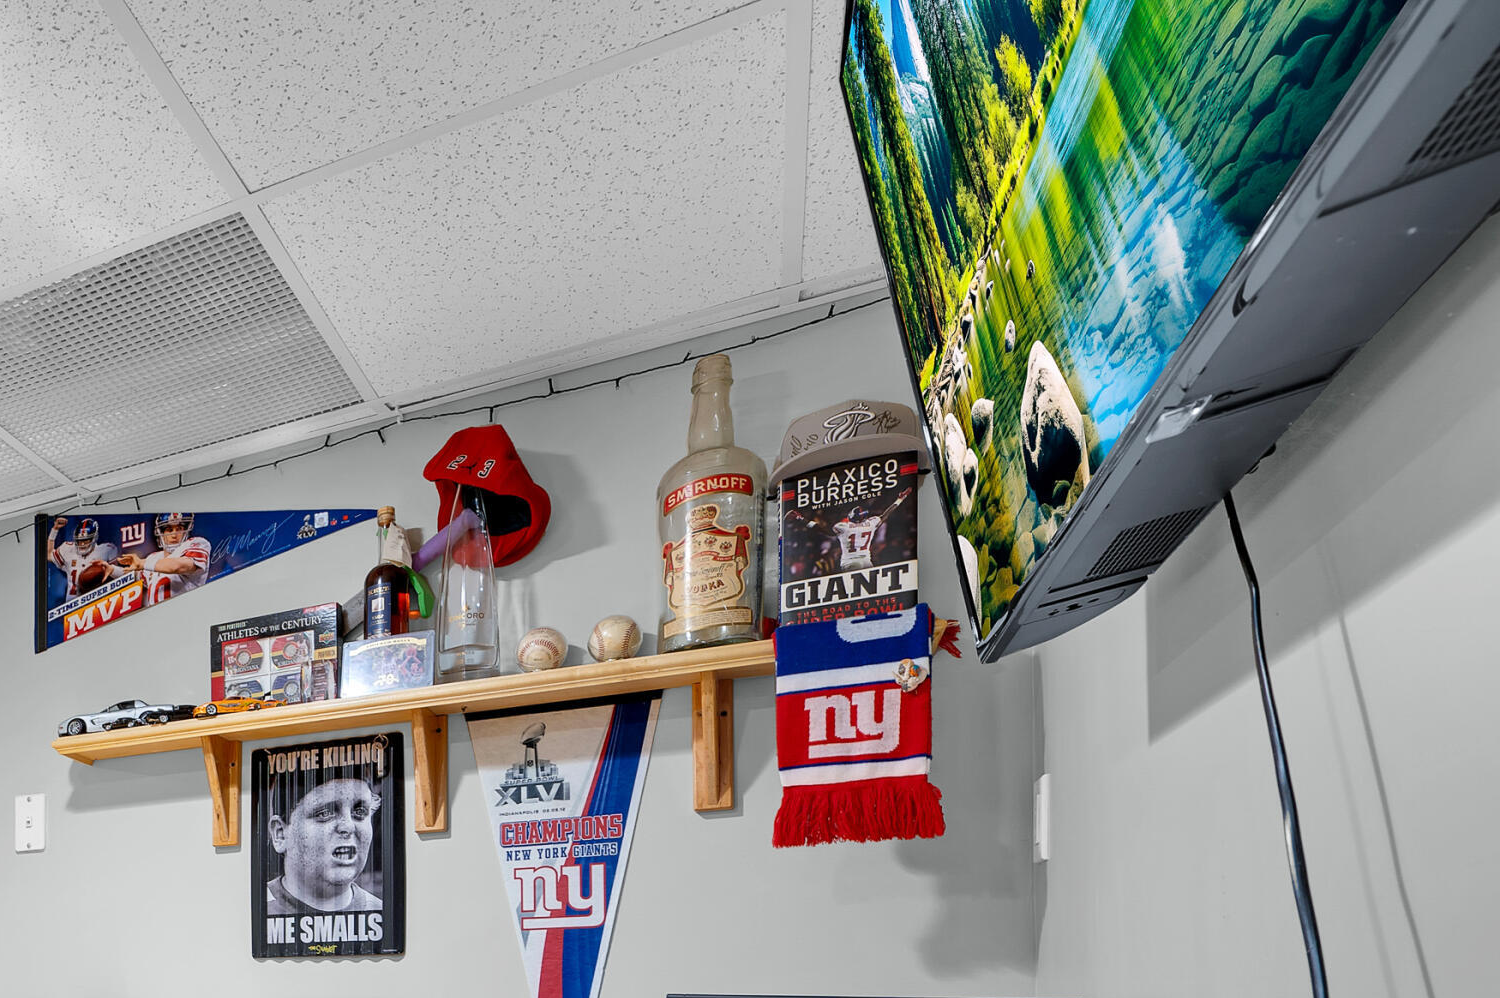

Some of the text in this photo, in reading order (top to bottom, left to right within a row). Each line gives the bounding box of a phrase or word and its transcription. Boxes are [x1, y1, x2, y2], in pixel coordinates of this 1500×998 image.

[477, 459, 496, 478] 3
[797, 459, 898, 493] PLAXICO
[797, 474, 898, 508] BURRESS
[812, 491, 882, 510] WITH JASON COLE
[120, 522, 146, 548] ny
[847, 532, 872, 553] 17
[80, 587, 108, 605] SUPER
[110, 574, 134, 589] BOWL
[785, 564, 909, 609] GIANT
[66, 585, 142, 640] MVP
[797, 596, 897, 619] THE ROAD TO THE
[217, 627, 260, 643] ATHLETES
[281, 615, 323, 631] CENTURY
[804, 688, 902, 759] ny
[267, 748, 320, 775] YOU'RE
[494, 782, 570, 807] XLVI
[499, 809, 539, 817] INDIANAPOLIS
[500, 814, 623, 847] CHAMPIONS
[506, 842, 618, 862] NEW YORK GIANTS
[514, 862, 606, 931] ny
[266, 912, 383, 944] ME SMALLS
